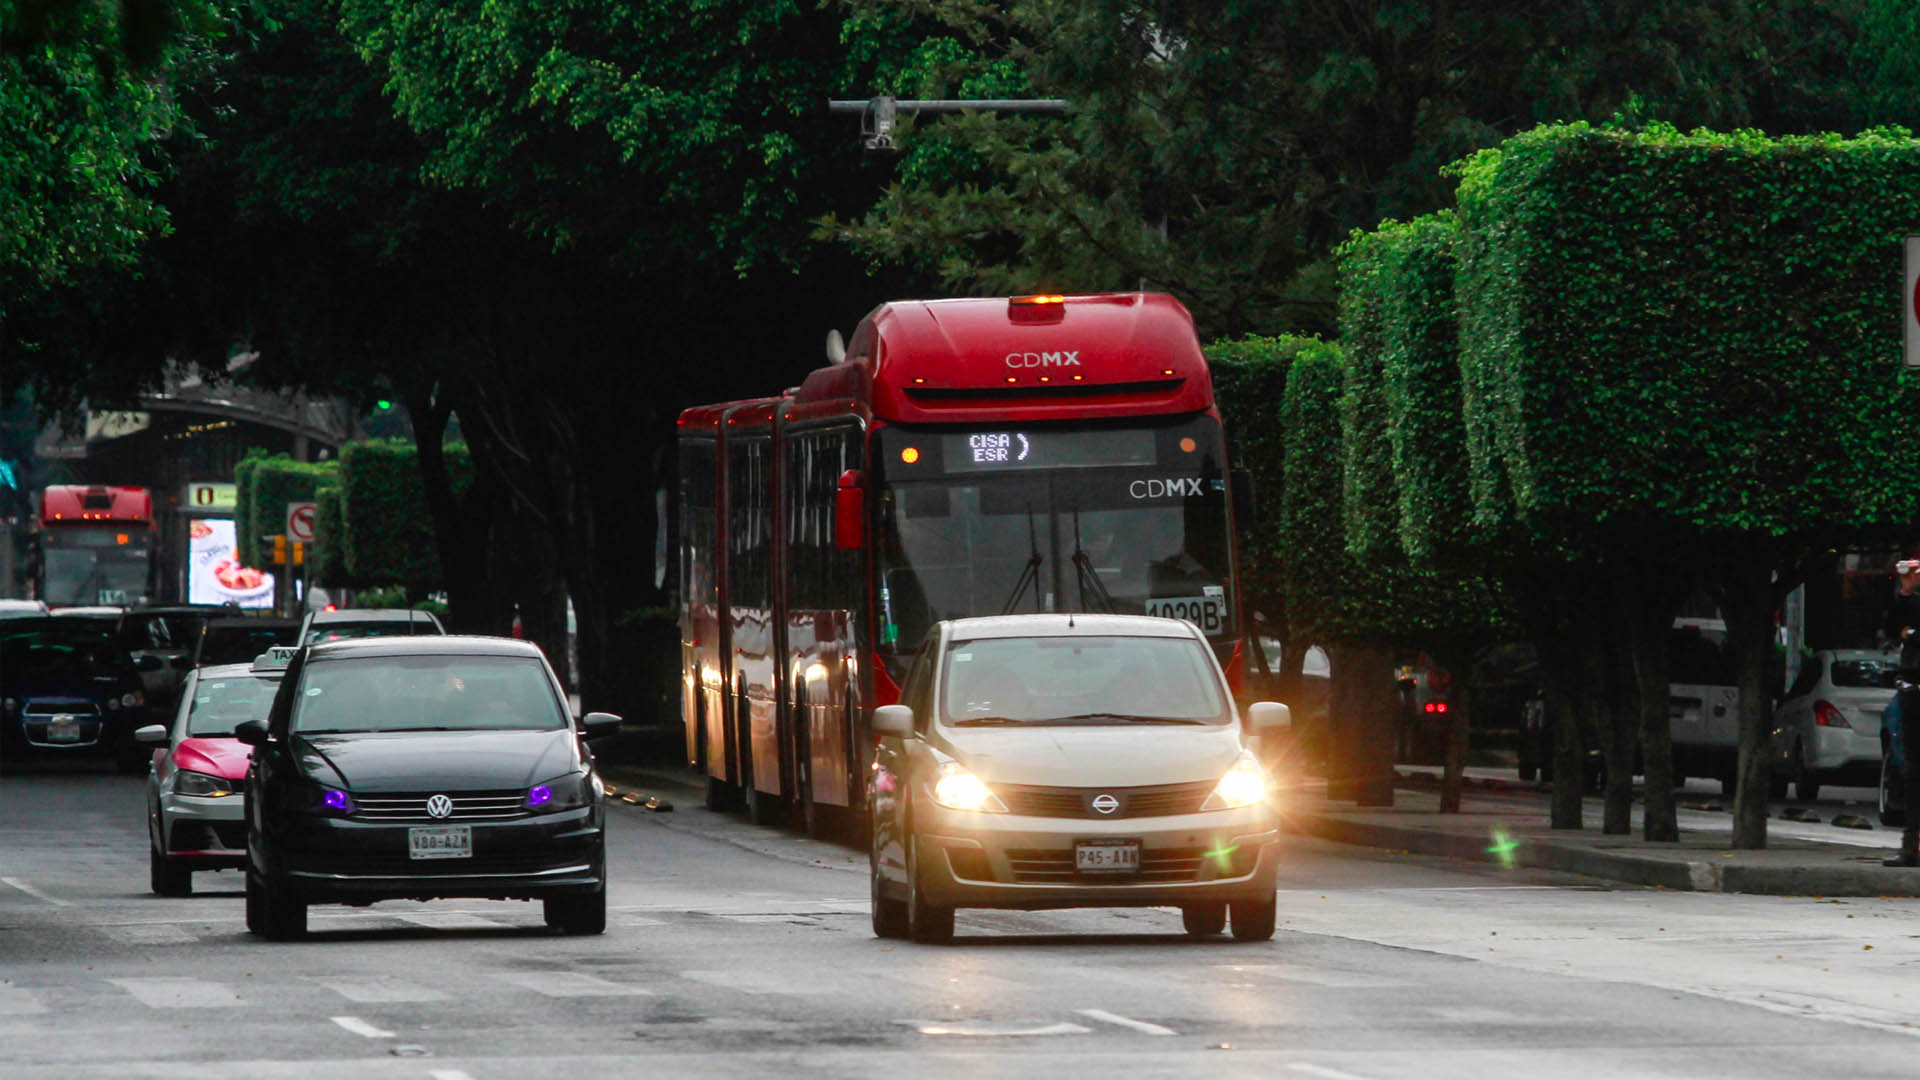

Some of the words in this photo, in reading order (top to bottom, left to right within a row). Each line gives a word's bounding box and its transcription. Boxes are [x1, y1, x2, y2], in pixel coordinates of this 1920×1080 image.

[1005, 351, 1080, 368] CDMX
[969, 433, 1009, 448] CISA
[973, 448, 1008, 462] ESR
[1129, 478, 1204, 499] CDMX
[272, 649, 297, 660] TAX
